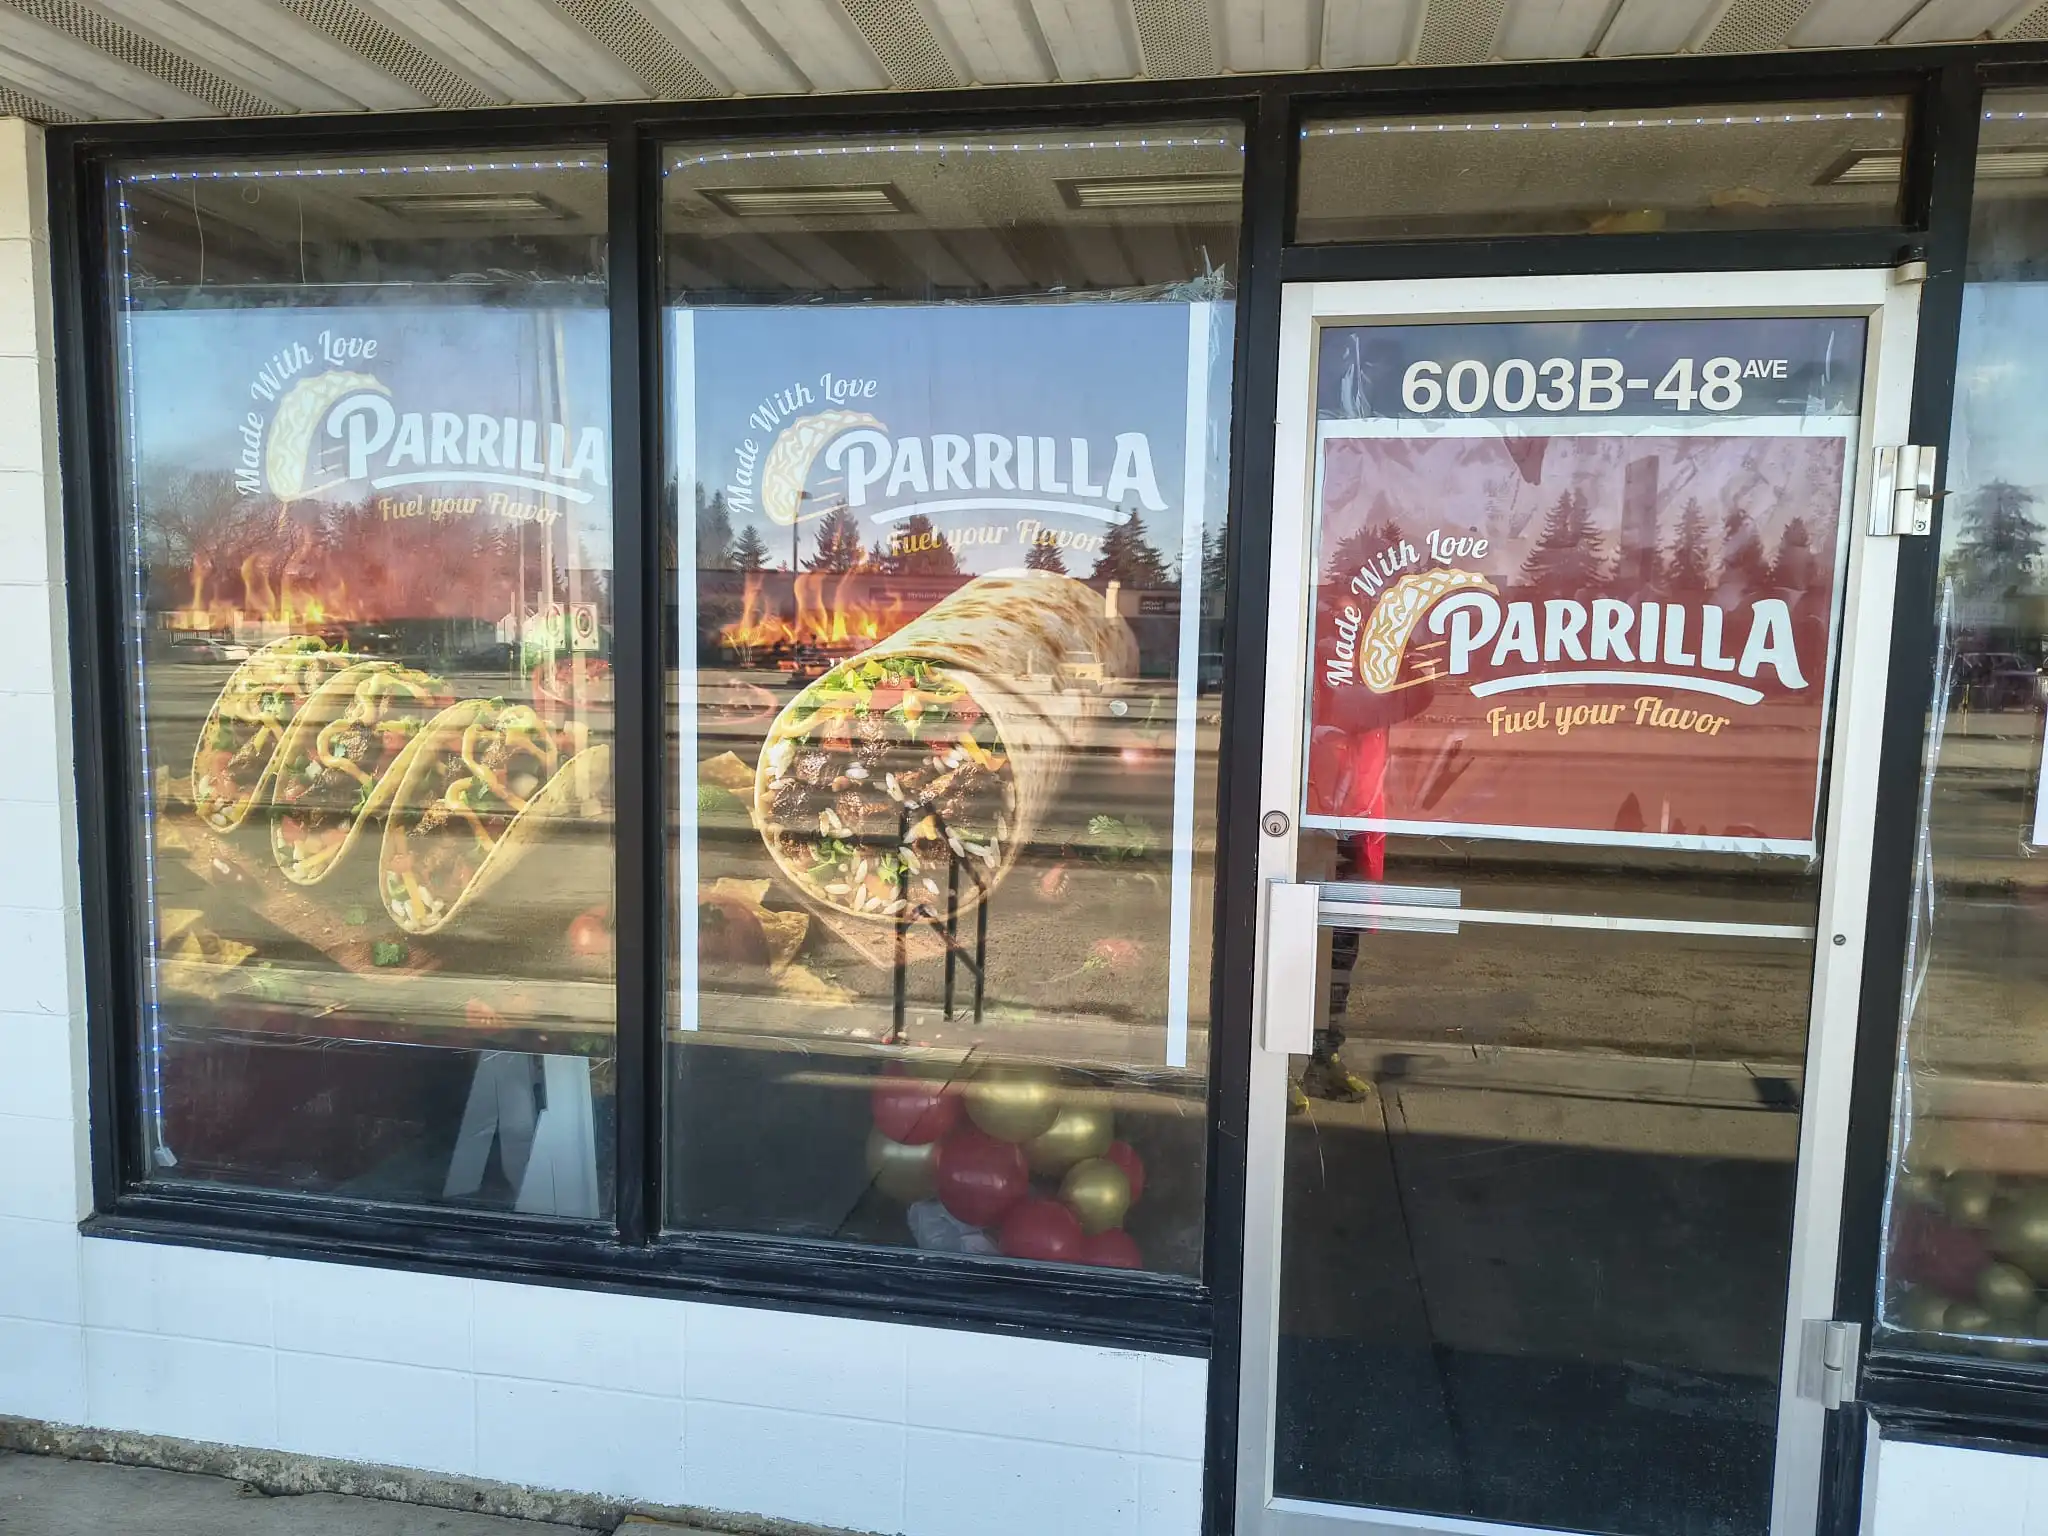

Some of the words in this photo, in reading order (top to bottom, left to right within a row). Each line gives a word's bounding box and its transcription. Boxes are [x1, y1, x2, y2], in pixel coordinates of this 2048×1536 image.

[235, 411, 264, 495] Made
[250, 341, 314, 401] With
[318, 329, 378, 366] Love
[1401, 357, 1743, 413] 6003B-48
[1742, 359, 1788, 379] AVE
[327, 394, 608, 486] PARRILLA
[727, 438, 759, 513] Made
[749, 382, 815, 433] With
[820, 372, 878, 405] Love
[825, 429, 1169, 511] PARRILLA
[378, 494, 425, 522] Fuel
[430, 496, 482, 521] your
[488, 492, 563, 526] Flavor
[886, 524, 942, 557] Fuel
[947, 526, 1009, 554] your
[1016, 519, 1106, 553] Flavor
[1326, 606, 1362, 686] Made
[1351, 540, 1420, 597] With
[1426, 529, 1489, 564] Love
[1428, 592, 1809, 690] PARRILLA
[1486, 702, 1549, 737] Fuel
[1555, 704, 1626, 736] your
[1633, 696, 1730, 736] Flavor
